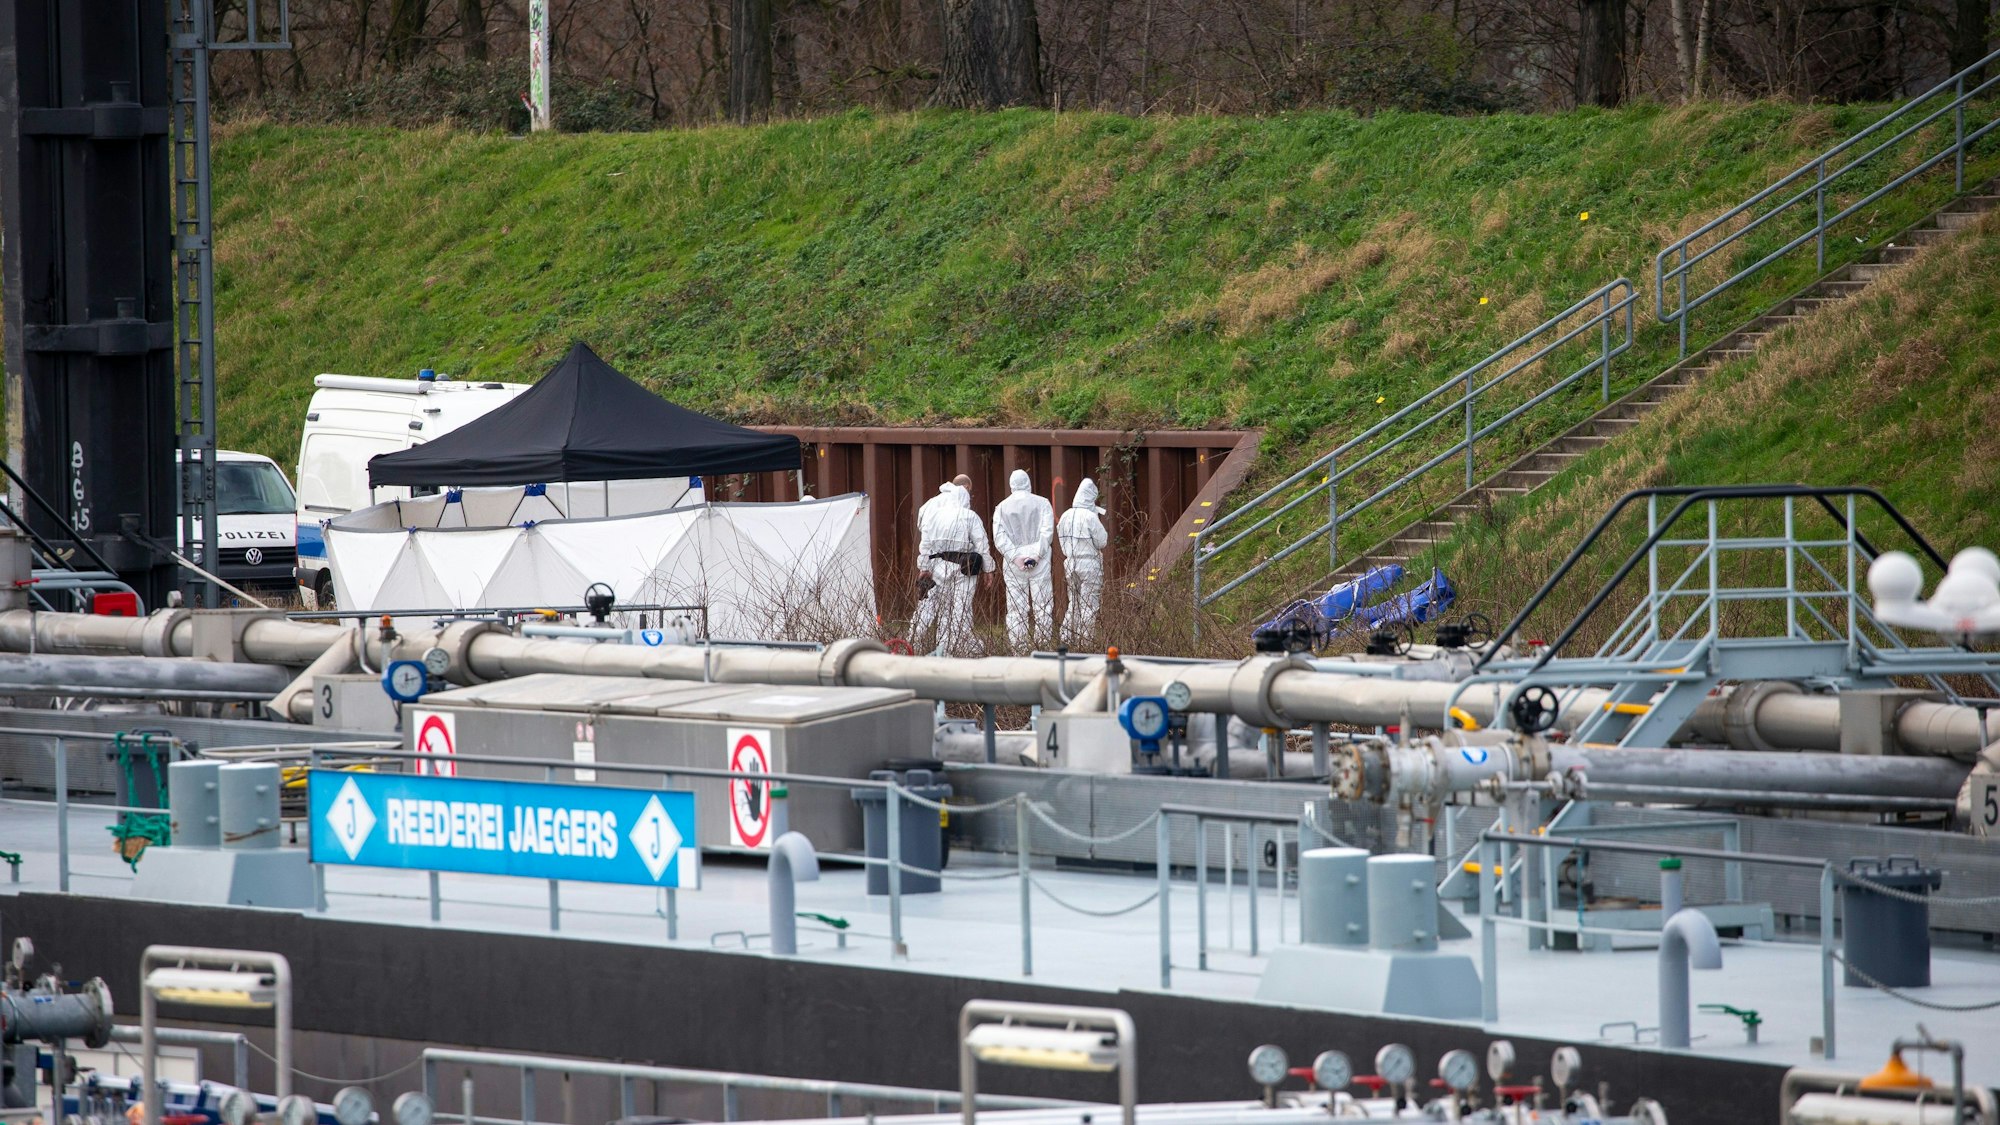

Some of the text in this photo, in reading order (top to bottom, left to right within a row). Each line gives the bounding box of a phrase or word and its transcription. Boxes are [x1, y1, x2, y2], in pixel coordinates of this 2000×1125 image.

[322, 684, 333, 719] 3
[1046, 721, 1059, 758] 4
[1984, 784, 1999, 826] 5
[387, 797, 619, 860] REEDEREI JAEGERS
